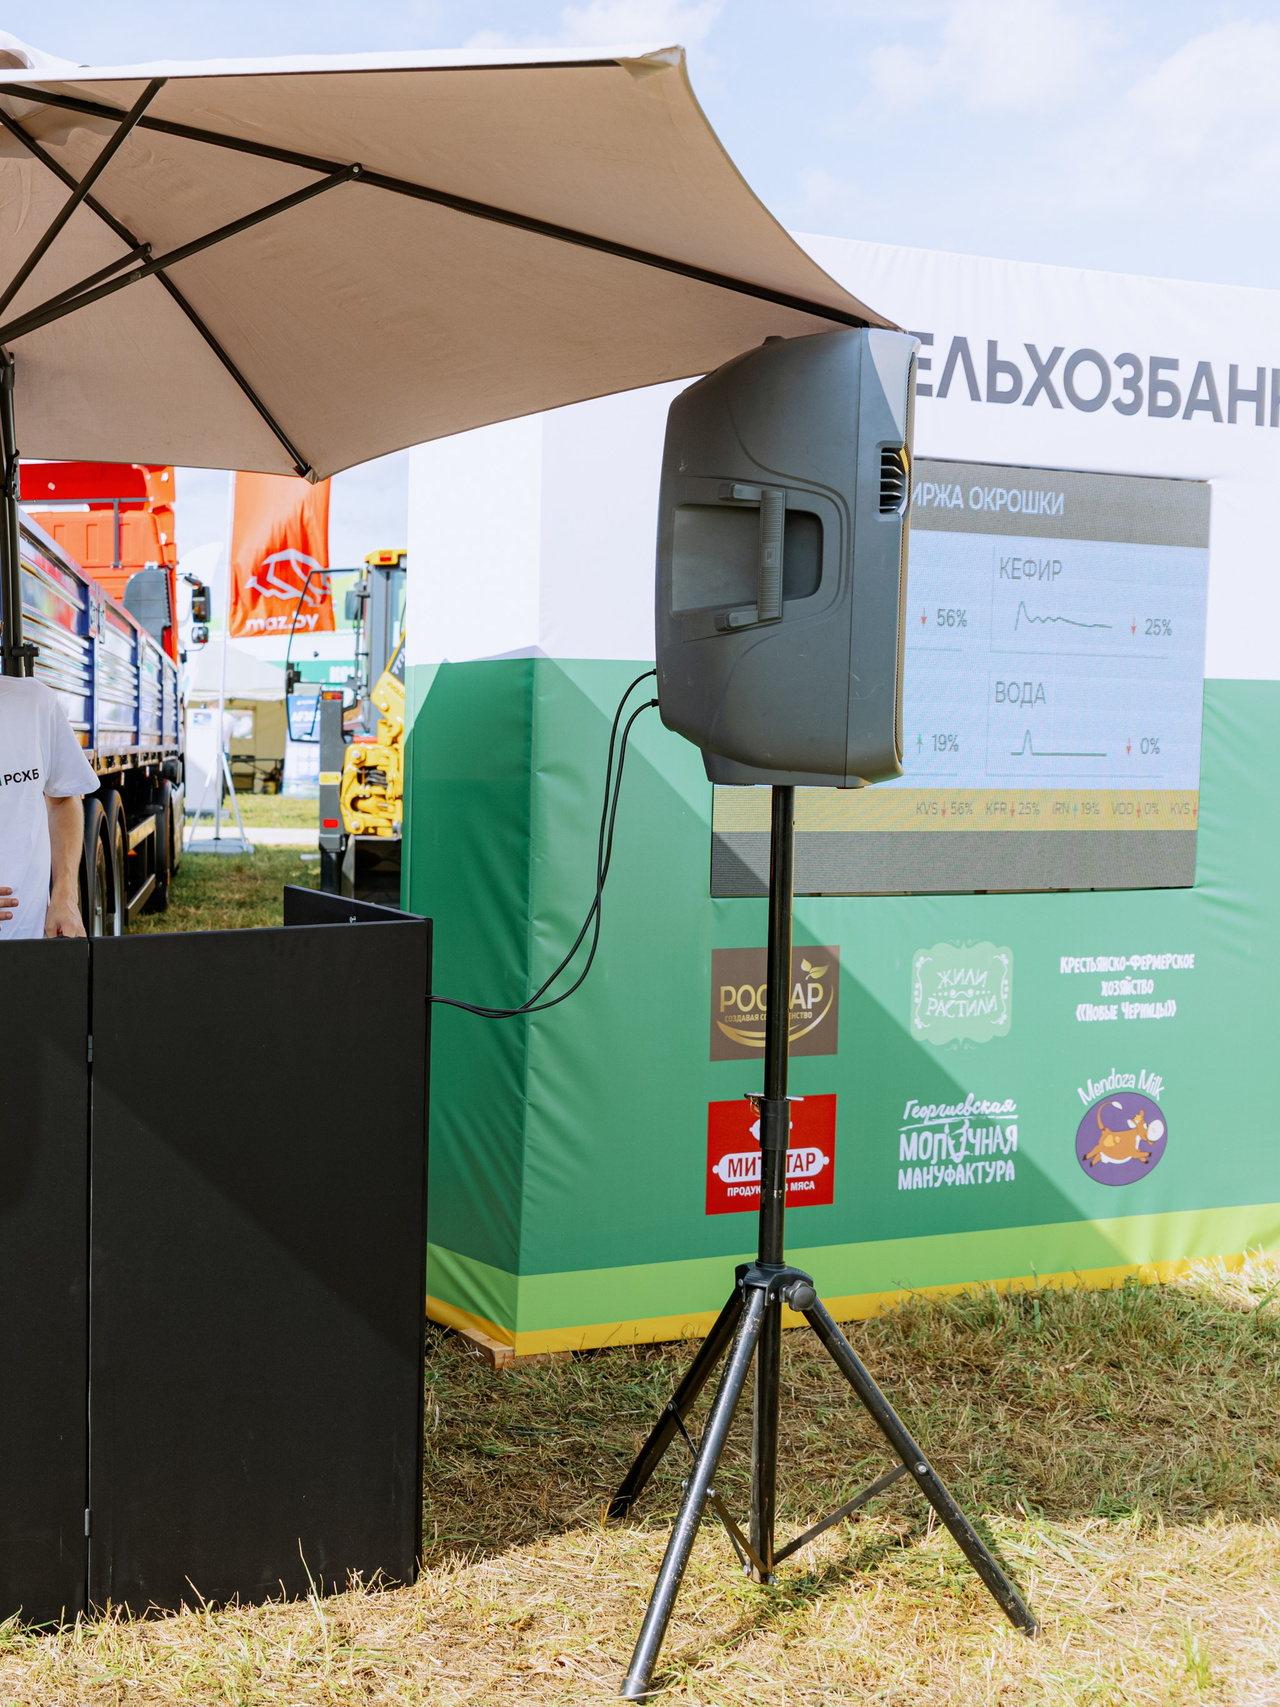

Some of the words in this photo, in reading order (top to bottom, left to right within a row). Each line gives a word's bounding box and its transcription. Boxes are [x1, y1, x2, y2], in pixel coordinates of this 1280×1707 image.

[969, 485, 1065, 516] ОКРОШКИ
[999, 556, 1062, 581] КЕФИР
[245, 610, 319, 632] maz.by
[936, 608, 968, 628] 56%
[1144, 618, 1173, 636] 25%
[995, 680, 1047, 708] ВОДА
[932, 734, 959, 752] 19%
[1140, 737, 1160, 755] 0%
[3, 768, 40, 786] РСХБ
[936, 967, 988, 989] ЖИЛИ
[720, 983, 824, 1013] РОСАР
[925, 994, 998, 1018] РАСТИЛИ
[725, 1013, 759, 1023] СОЗДАВАЯ
[1077, 1067, 1136, 1106] Mendoza
[1137, 1069, 1165, 1102] Milk
[903, 1092, 1017, 1125] Георгиевская
[728, 1152, 816, 1178] МИТАР
[898, 1160, 1016, 1191] МАНУФАКТУРА
[727, 1185, 761, 1197] ПРОДУК
[790, 1181, 815, 1192] МЯСА
